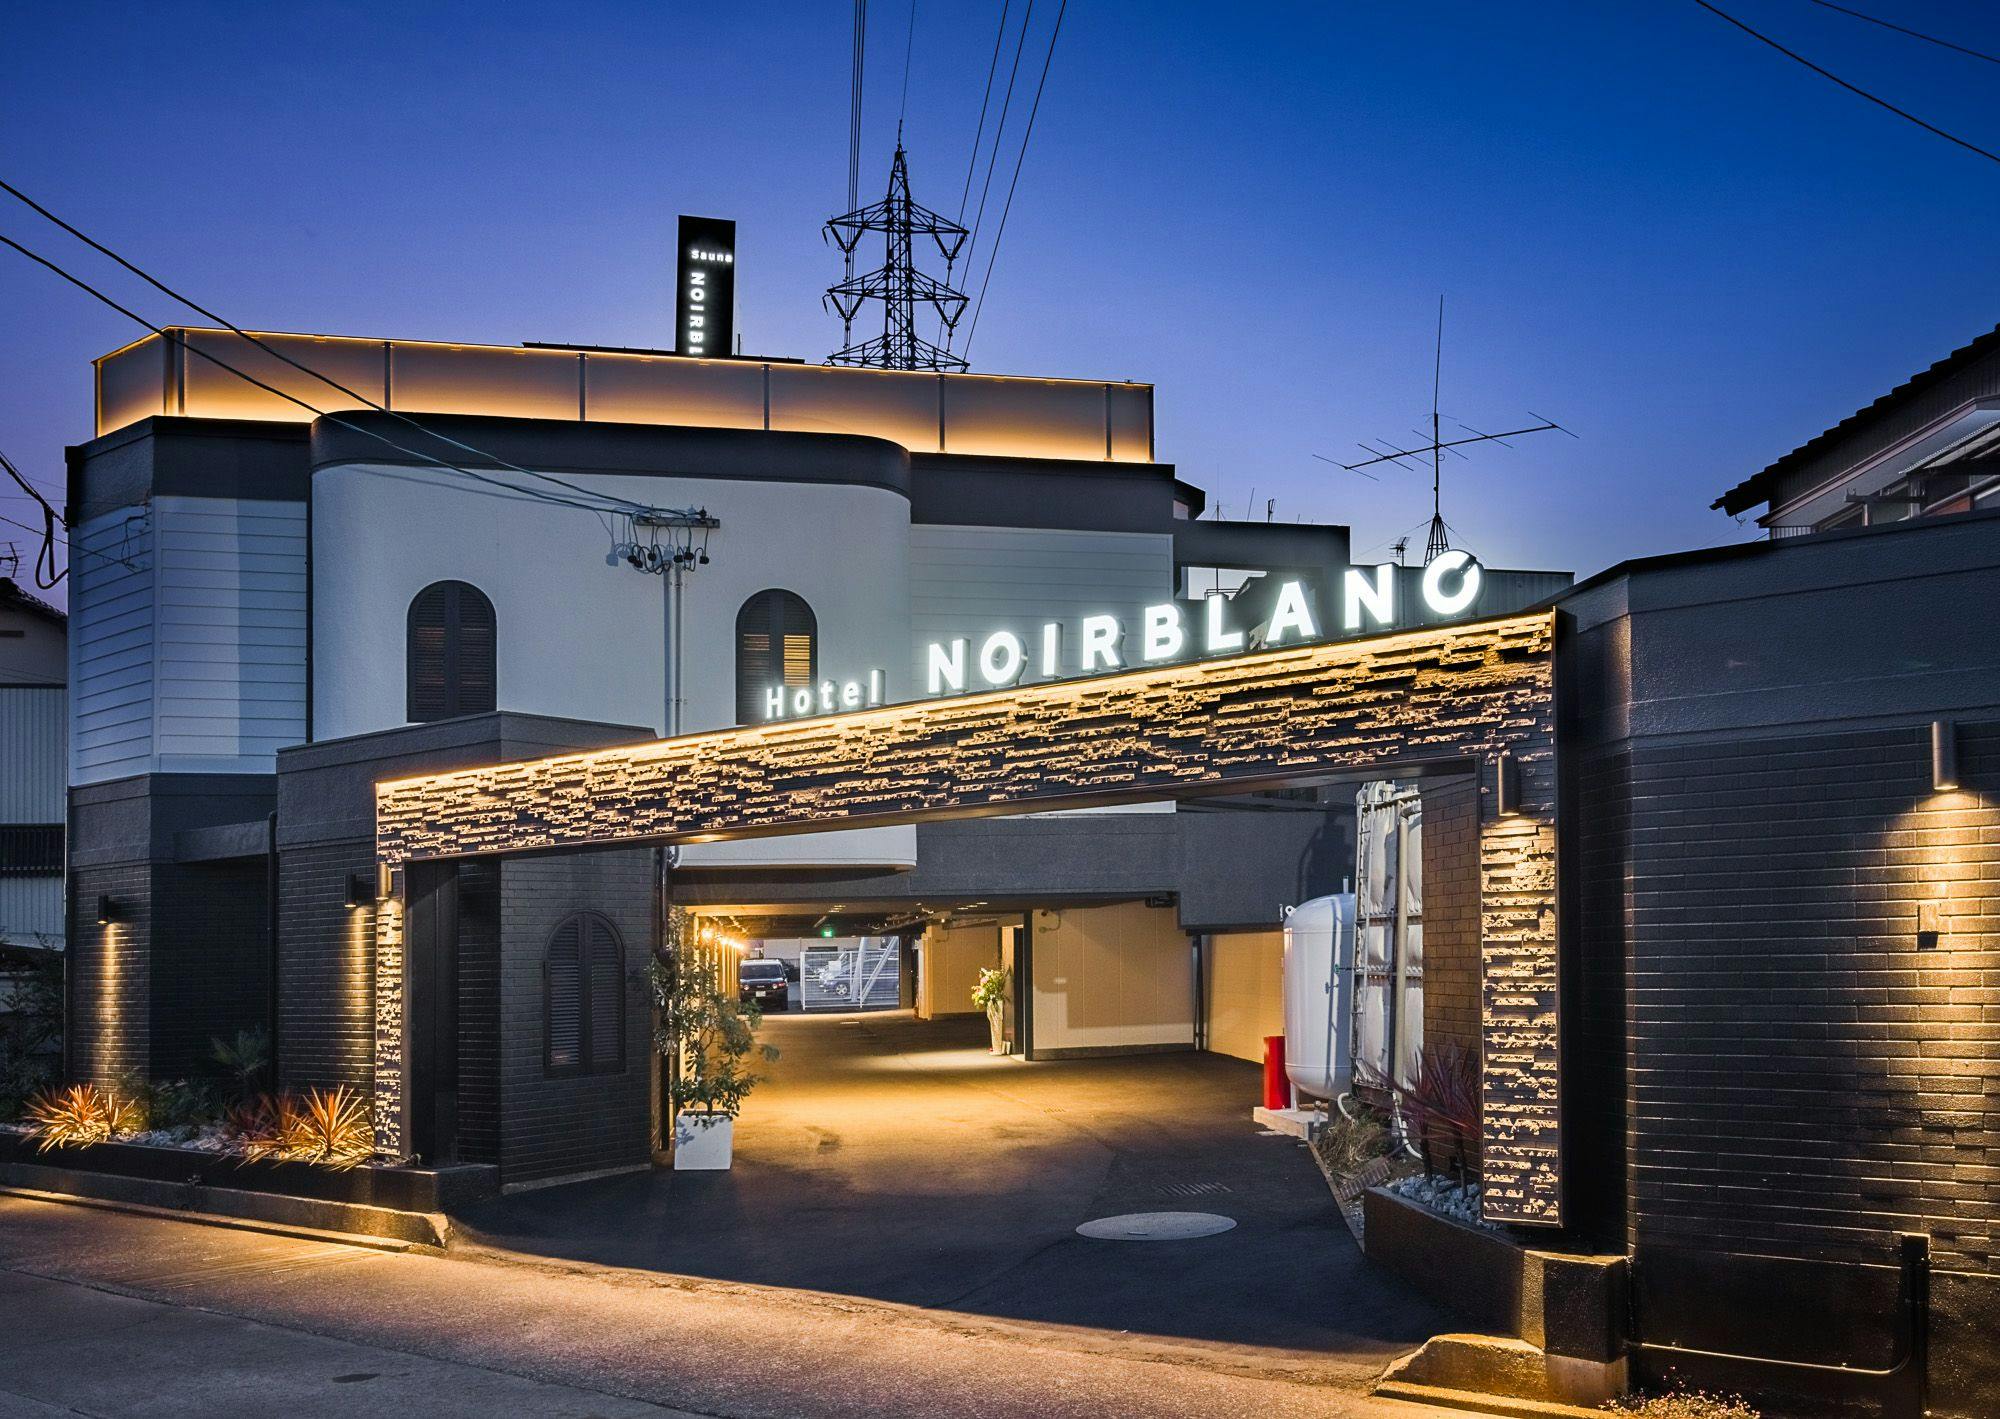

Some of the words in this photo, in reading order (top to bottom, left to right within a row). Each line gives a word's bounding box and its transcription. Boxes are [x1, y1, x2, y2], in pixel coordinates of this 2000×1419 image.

[691, 249, 733, 263] Sauna
[764, 668, 881, 720] Hotel
[927, 549, 1482, 695] NOIRBLANC
